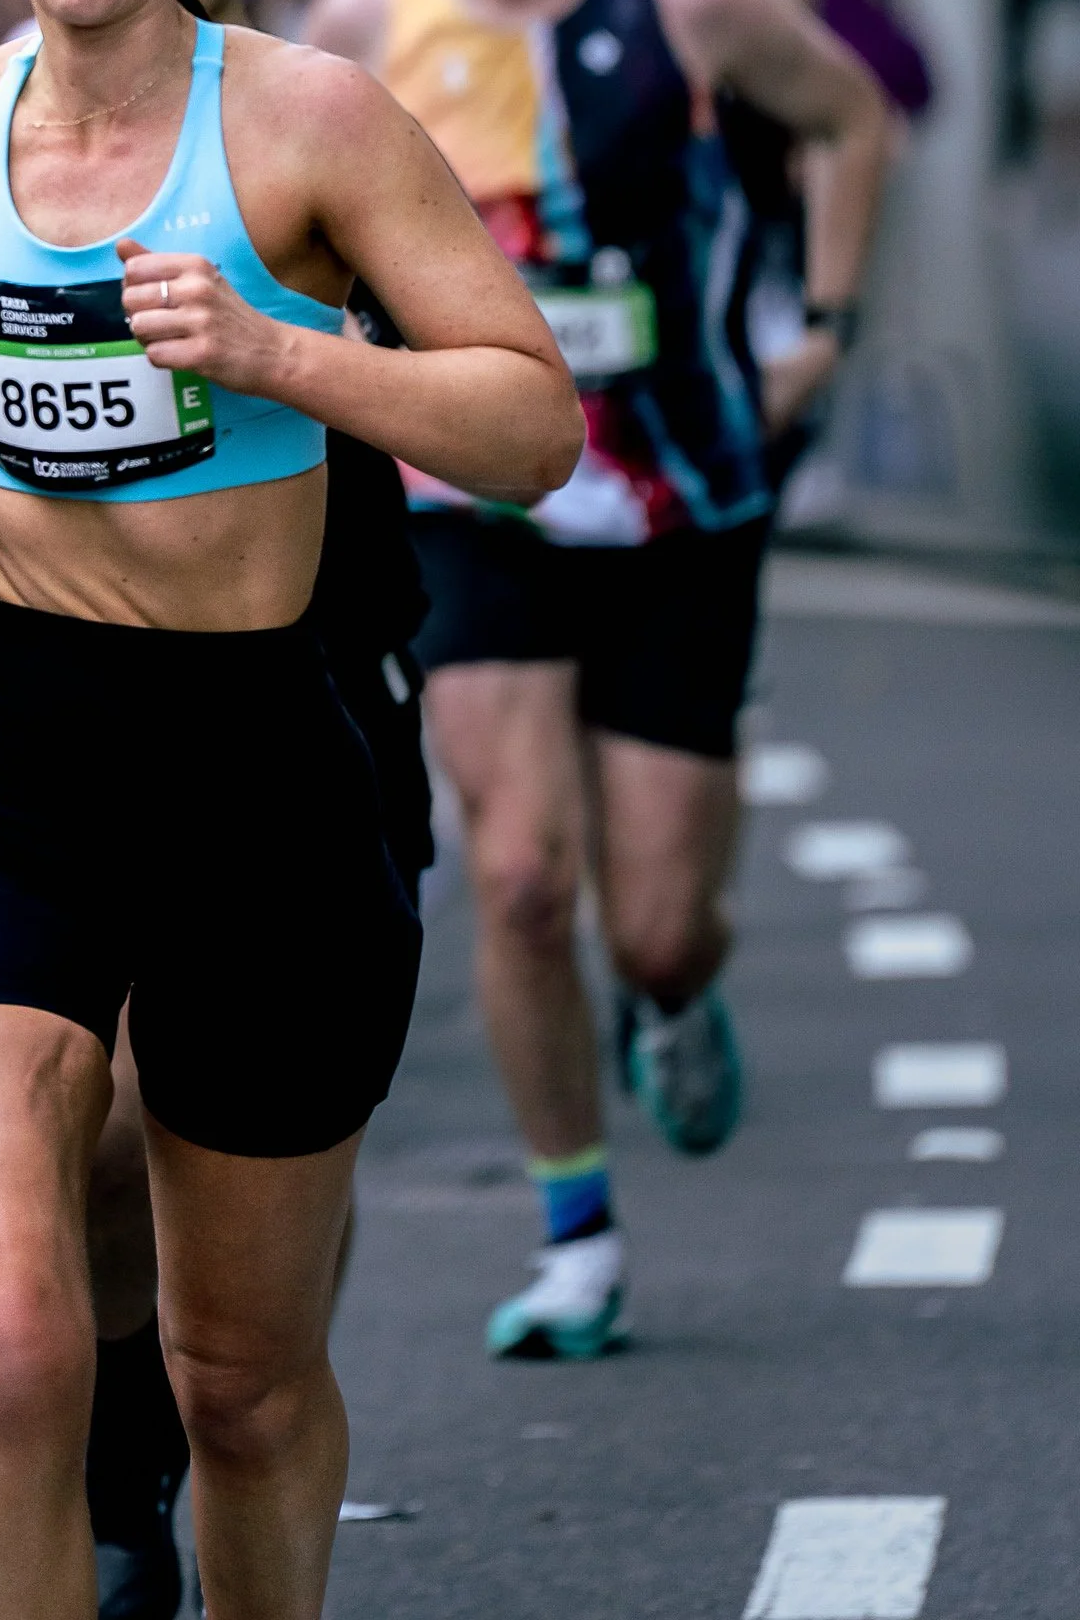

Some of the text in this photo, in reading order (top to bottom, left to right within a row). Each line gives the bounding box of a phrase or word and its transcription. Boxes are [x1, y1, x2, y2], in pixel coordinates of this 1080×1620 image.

[0, 295, 30, 311] TATA
[0, 309, 75, 325] CONSULTANCY
[1, 322, 48, 338] SERVICES
[1, 378, 135, 431] 8655
[182, 386, 202, 409] E
[32, 456, 60, 478] tcs
